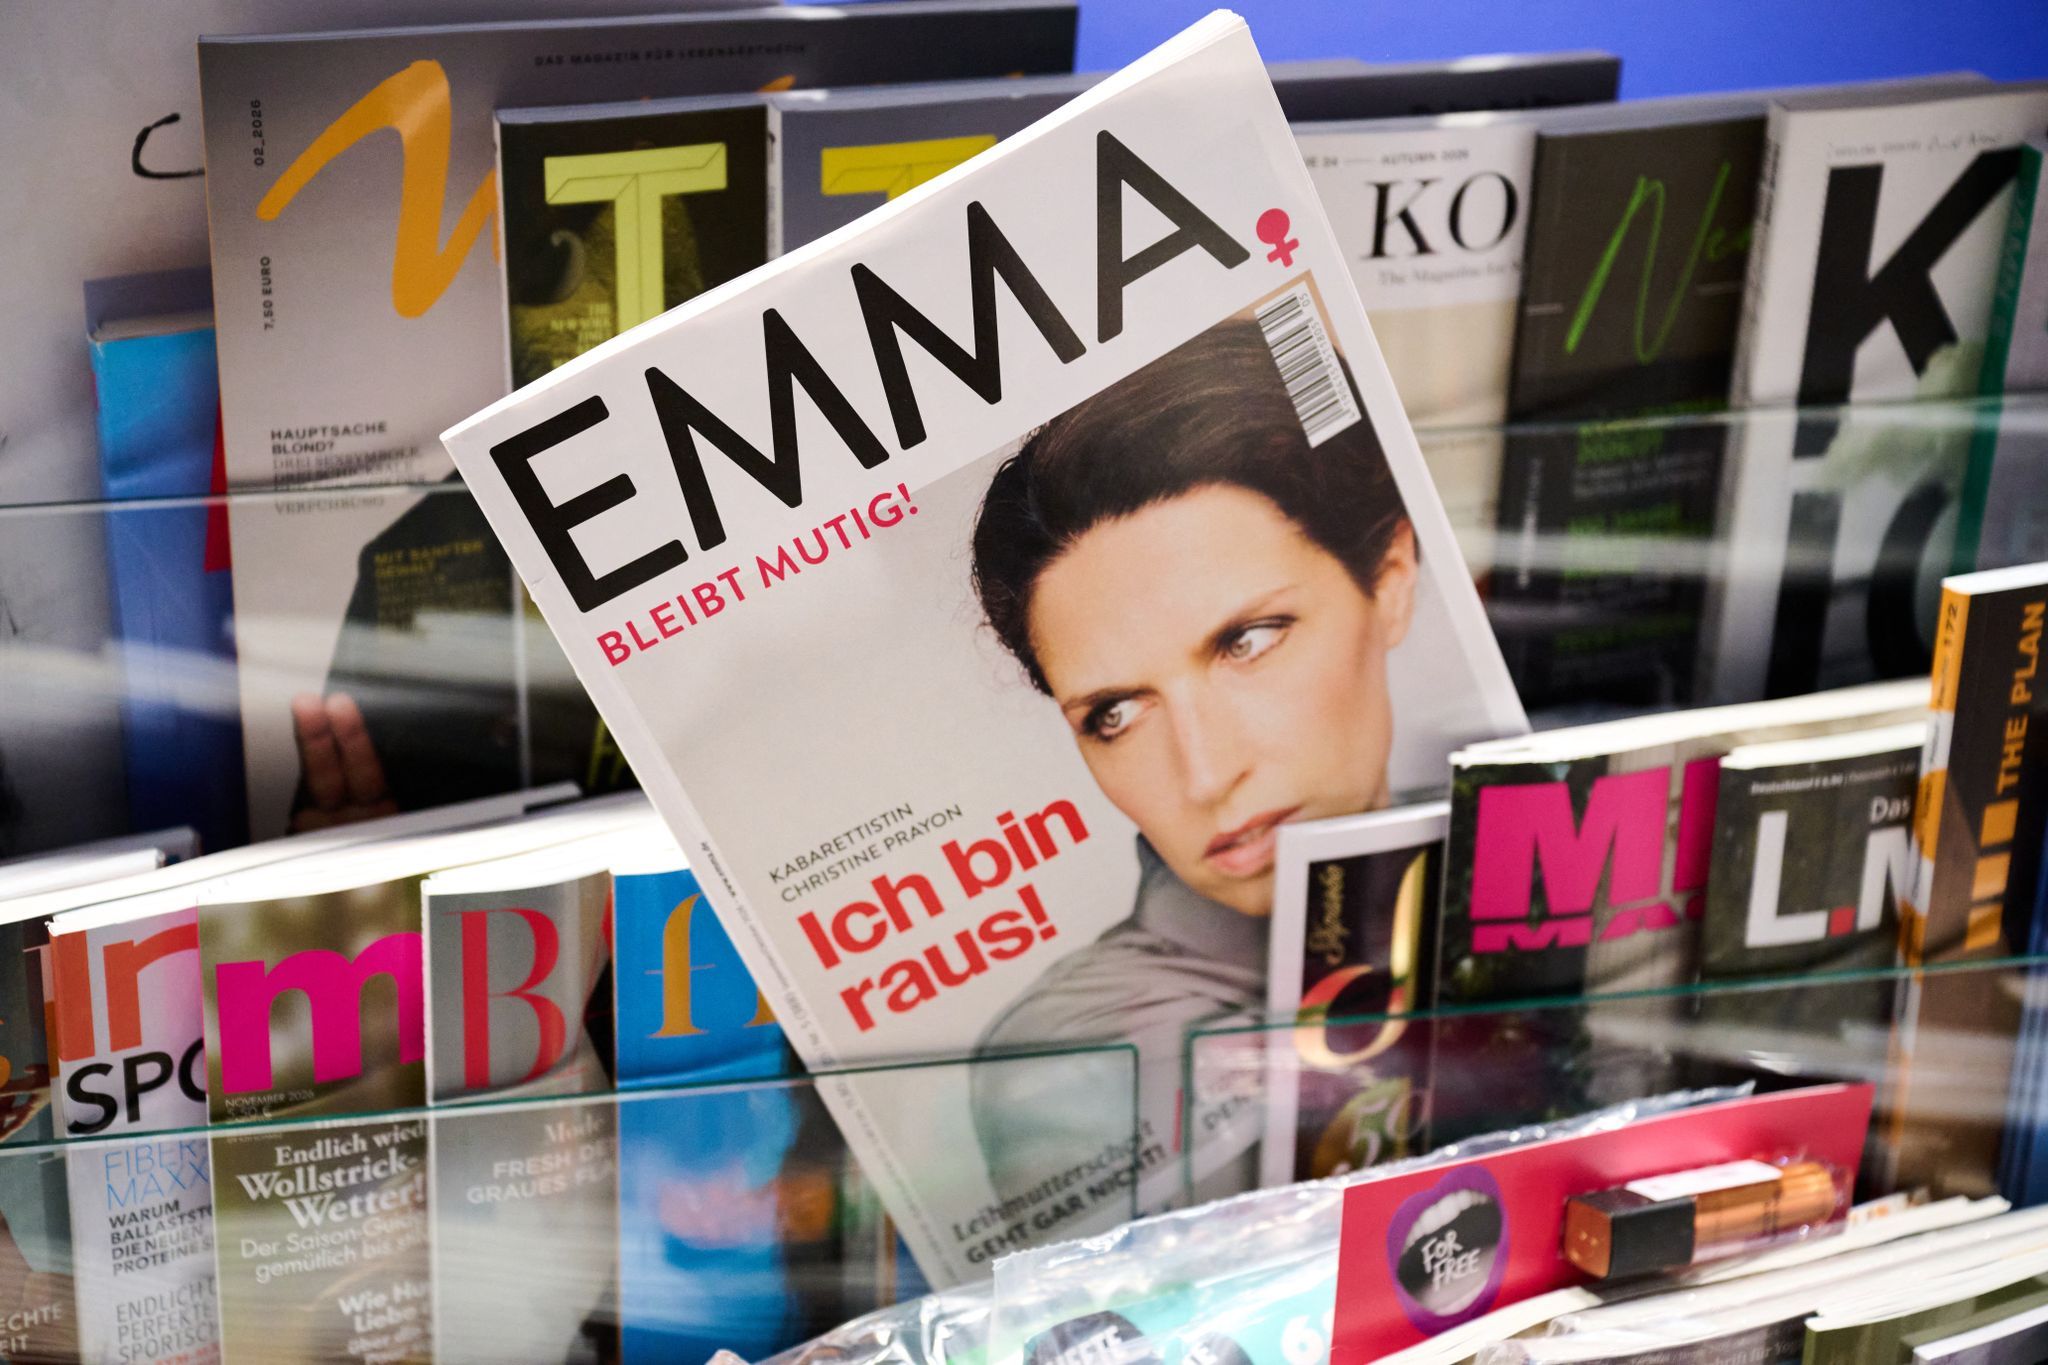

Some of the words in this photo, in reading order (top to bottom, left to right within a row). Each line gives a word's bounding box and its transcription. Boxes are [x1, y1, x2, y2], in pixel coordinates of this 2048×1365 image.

[260, 256, 273, 295] EURO
[489, 129, 1251, 614] EMMA
[271, 421, 388, 441] HAUPTSACHE
[272, 441, 335, 455] BLOND?
[597, 566, 746, 667] BLEIBT
[755, 483, 919, 589] MUTIG!
[2011, 600, 2047, 705] PLAN
[1996, 713, 2030, 796] THE
[769, 803, 914, 885] KABARETTISTIN
[780, 843, 883, 903] CHRISTINE
[884, 803, 964, 853] PRAYON
[797, 873, 946, 971] Ich
[940, 799, 1091, 900] bin
[839, 883, 1059, 1033] raus!
[274, 1132, 368, 1168] Endlich
[492, 1152, 572, 1180] FRESH
[236, 1148, 419, 1201] Wollstrick-
[466, 1174, 569, 1205] GRAUES
[109, 1199, 181, 1229] WARUM
[283, 1172, 424, 1230] Wetter!
[111, 1241, 142, 1260] DIE
[240, 1237, 281, 1260] Der
[965, 1221, 1030, 1265] GEHT
[1032, 1193, 1086, 1231] GAR
[255, 1245, 357, 1284] gemütlich
[1420, 1229, 1464, 1275] FOR
[1432, 1247, 1481, 1292] FREE
[338, 1289, 388, 1317] Wie
